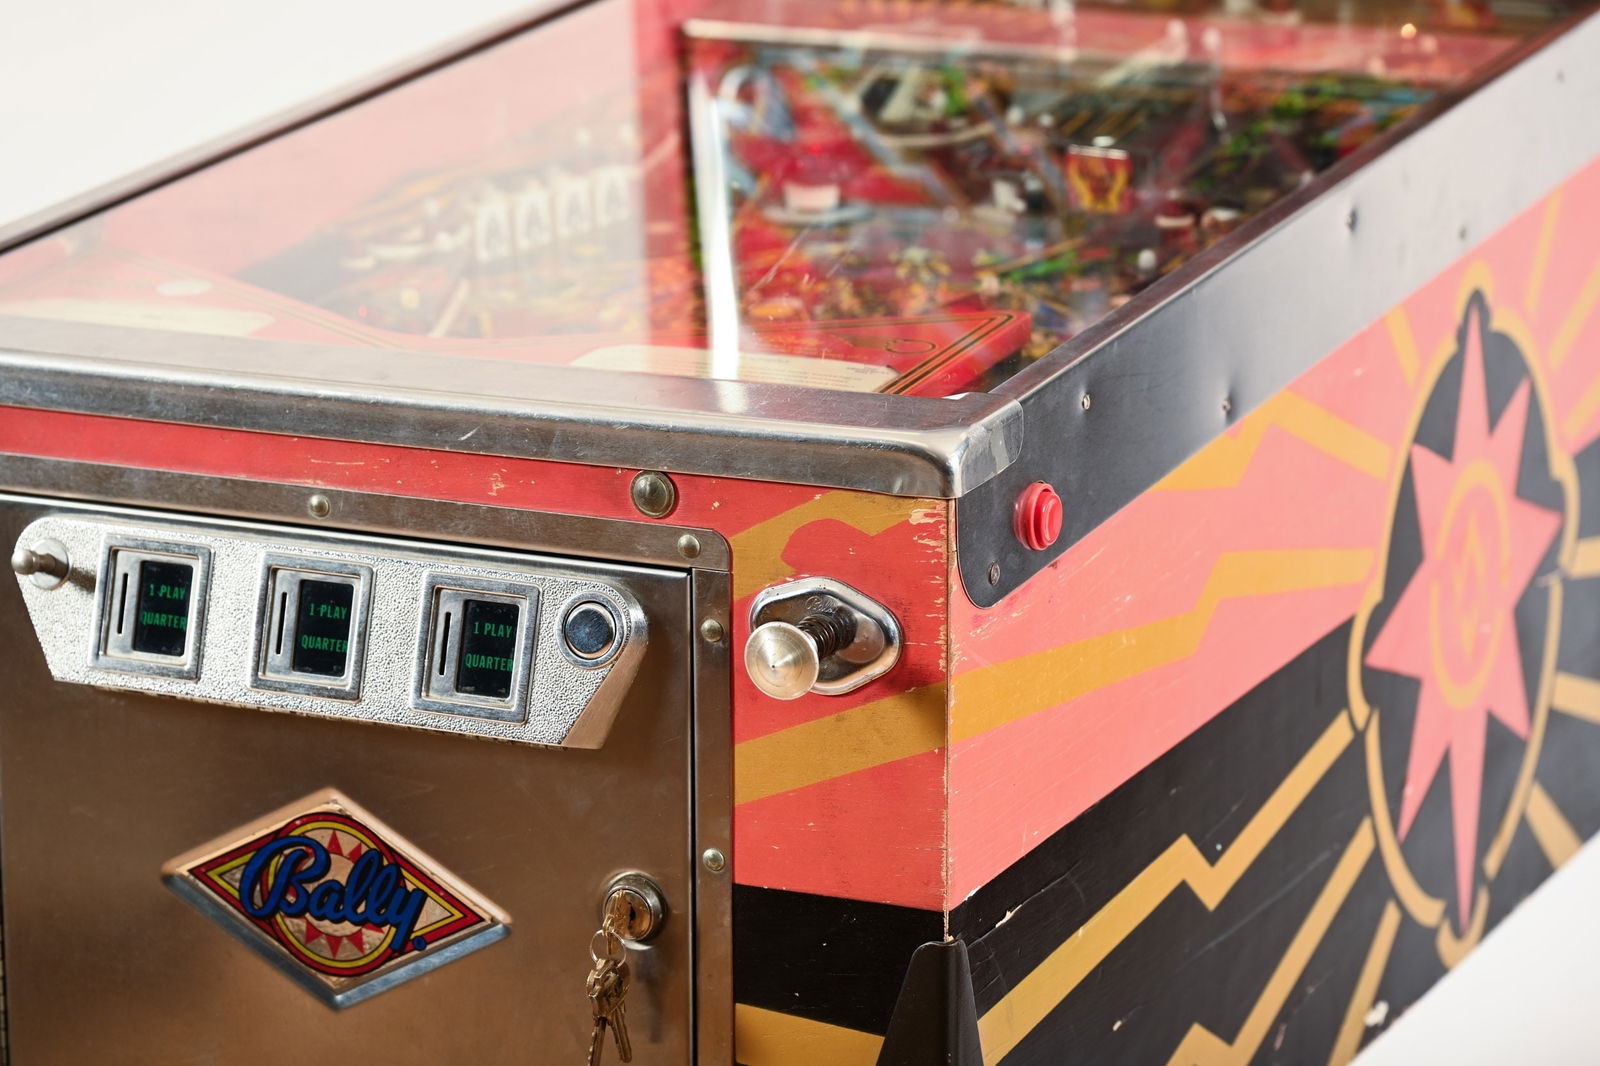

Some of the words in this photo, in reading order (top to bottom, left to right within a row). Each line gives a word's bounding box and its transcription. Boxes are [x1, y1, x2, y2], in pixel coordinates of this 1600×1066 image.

[149, 583, 155, 597] 1
[160, 584, 186, 601] PLAY
[309, 602, 315, 616] 1
[320, 604, 348, 620] PLAY
[473, 621, 480, 635] 1
[484, 622, 513, 638] PLAY
[301, 634, 349, 654] QUARTER
[465, 653, 514, 673] QUARTER
[239, 836, 428, 952] Bally
